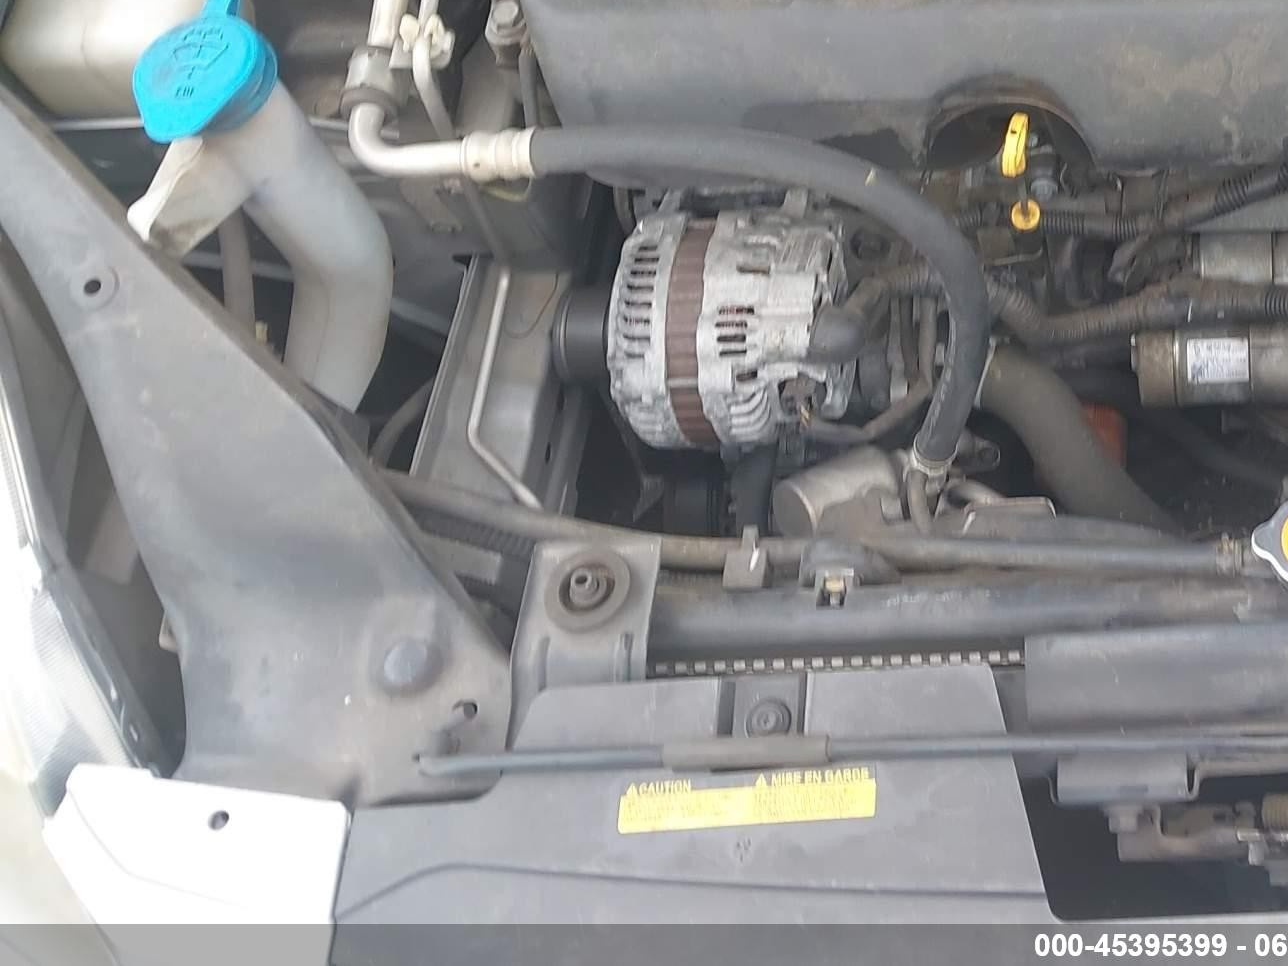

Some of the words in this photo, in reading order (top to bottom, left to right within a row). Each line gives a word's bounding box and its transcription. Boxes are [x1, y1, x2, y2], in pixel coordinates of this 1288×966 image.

[805, 769, 822, 783] EN
[825, 767, 869, 782] GARDE
[638, 779, 691, 794] CAUTION
